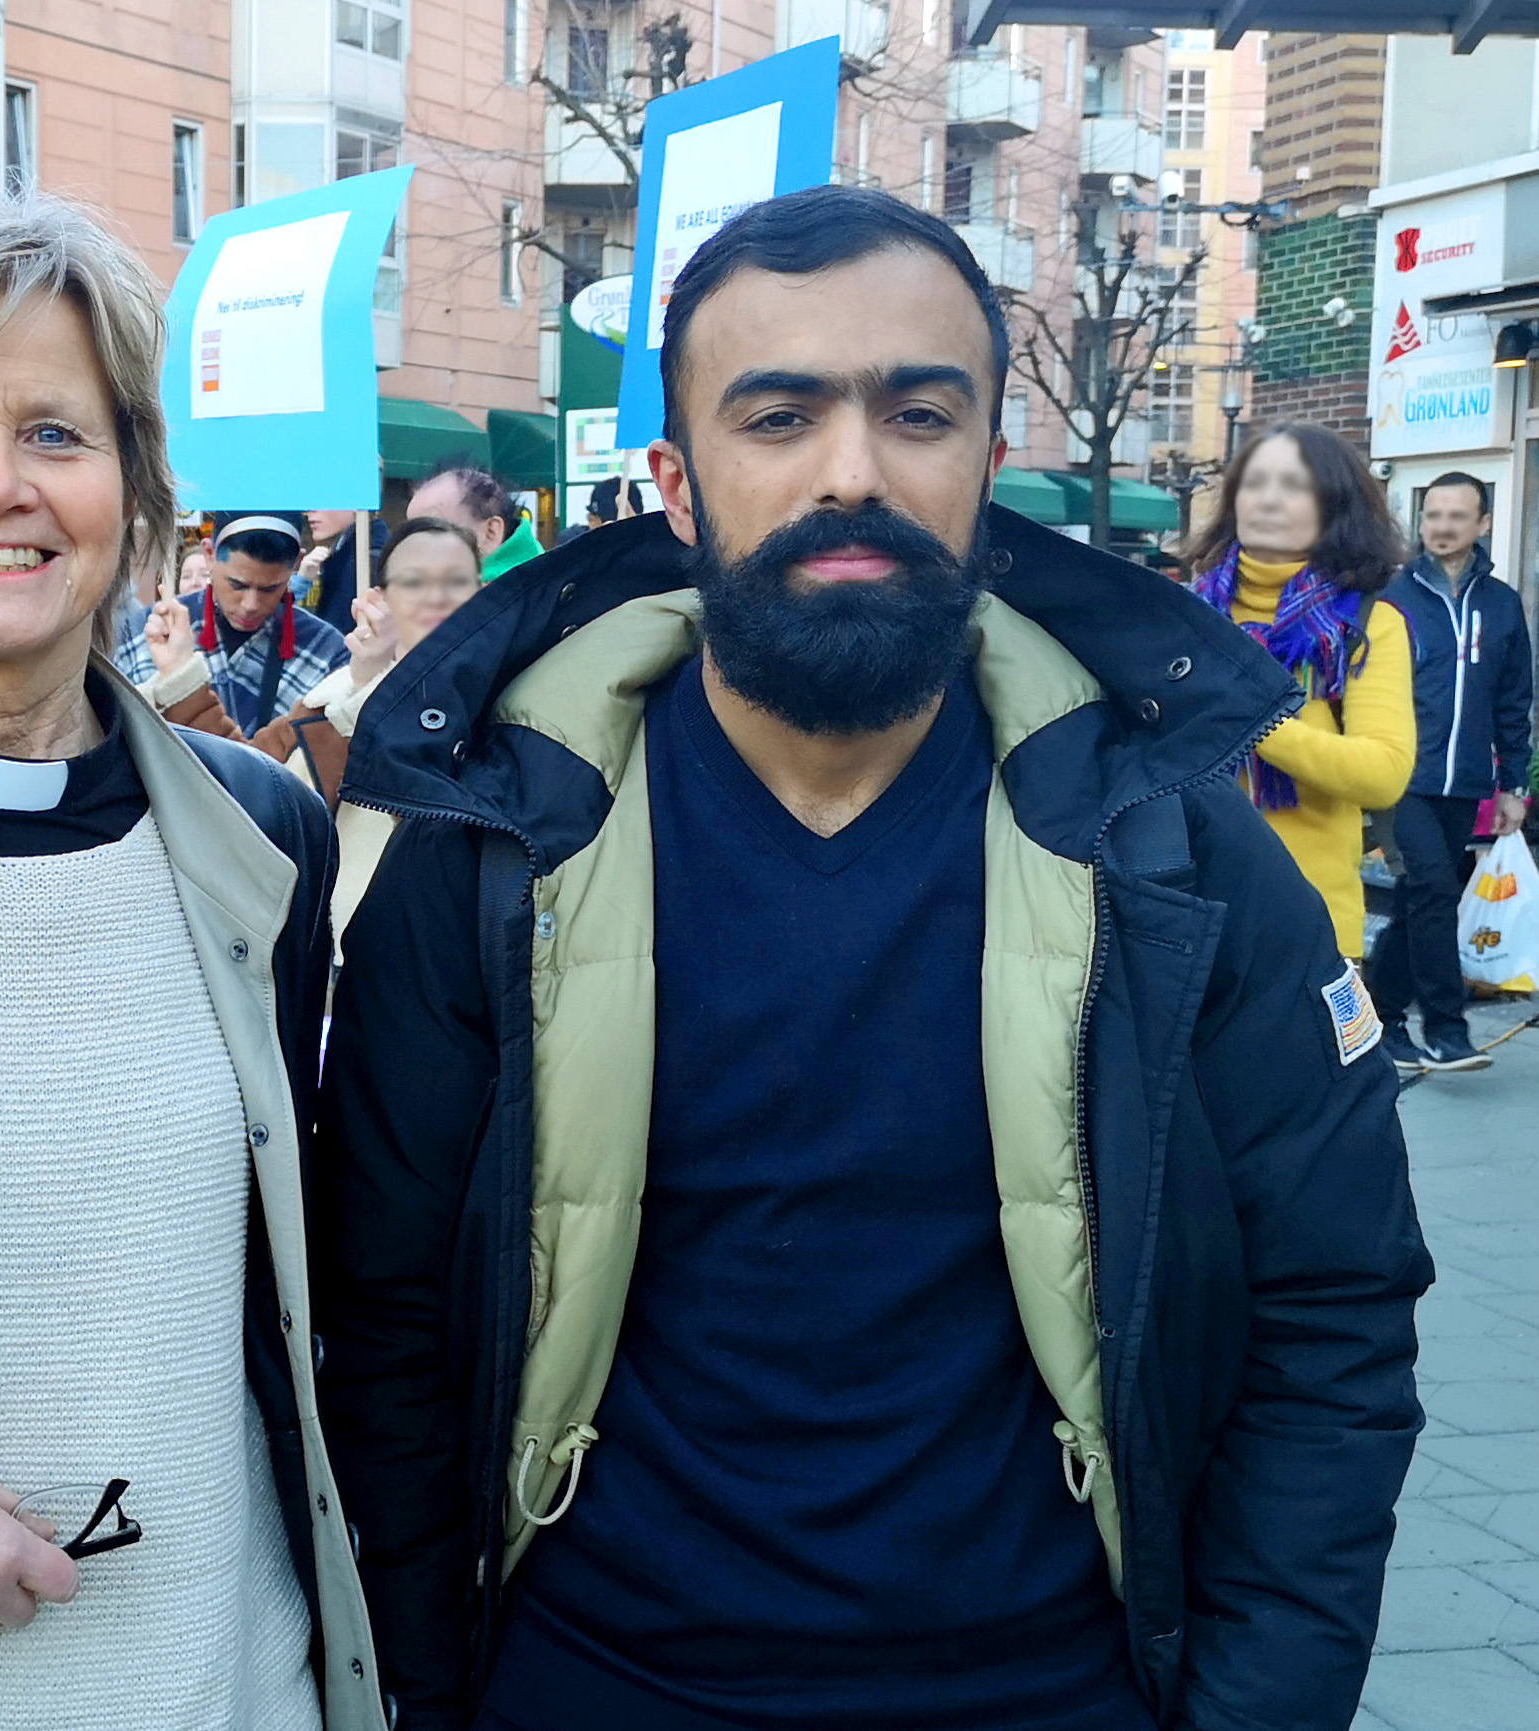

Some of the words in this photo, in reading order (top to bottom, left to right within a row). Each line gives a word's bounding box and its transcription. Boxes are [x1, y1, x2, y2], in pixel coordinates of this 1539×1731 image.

[687, 210, 704, 228] ARE
[706, 207, 718, 224] ALL
[1420, 241, 1475, 265] SECURITY
[1404, 387, 1490, 422] GRØNLAND
